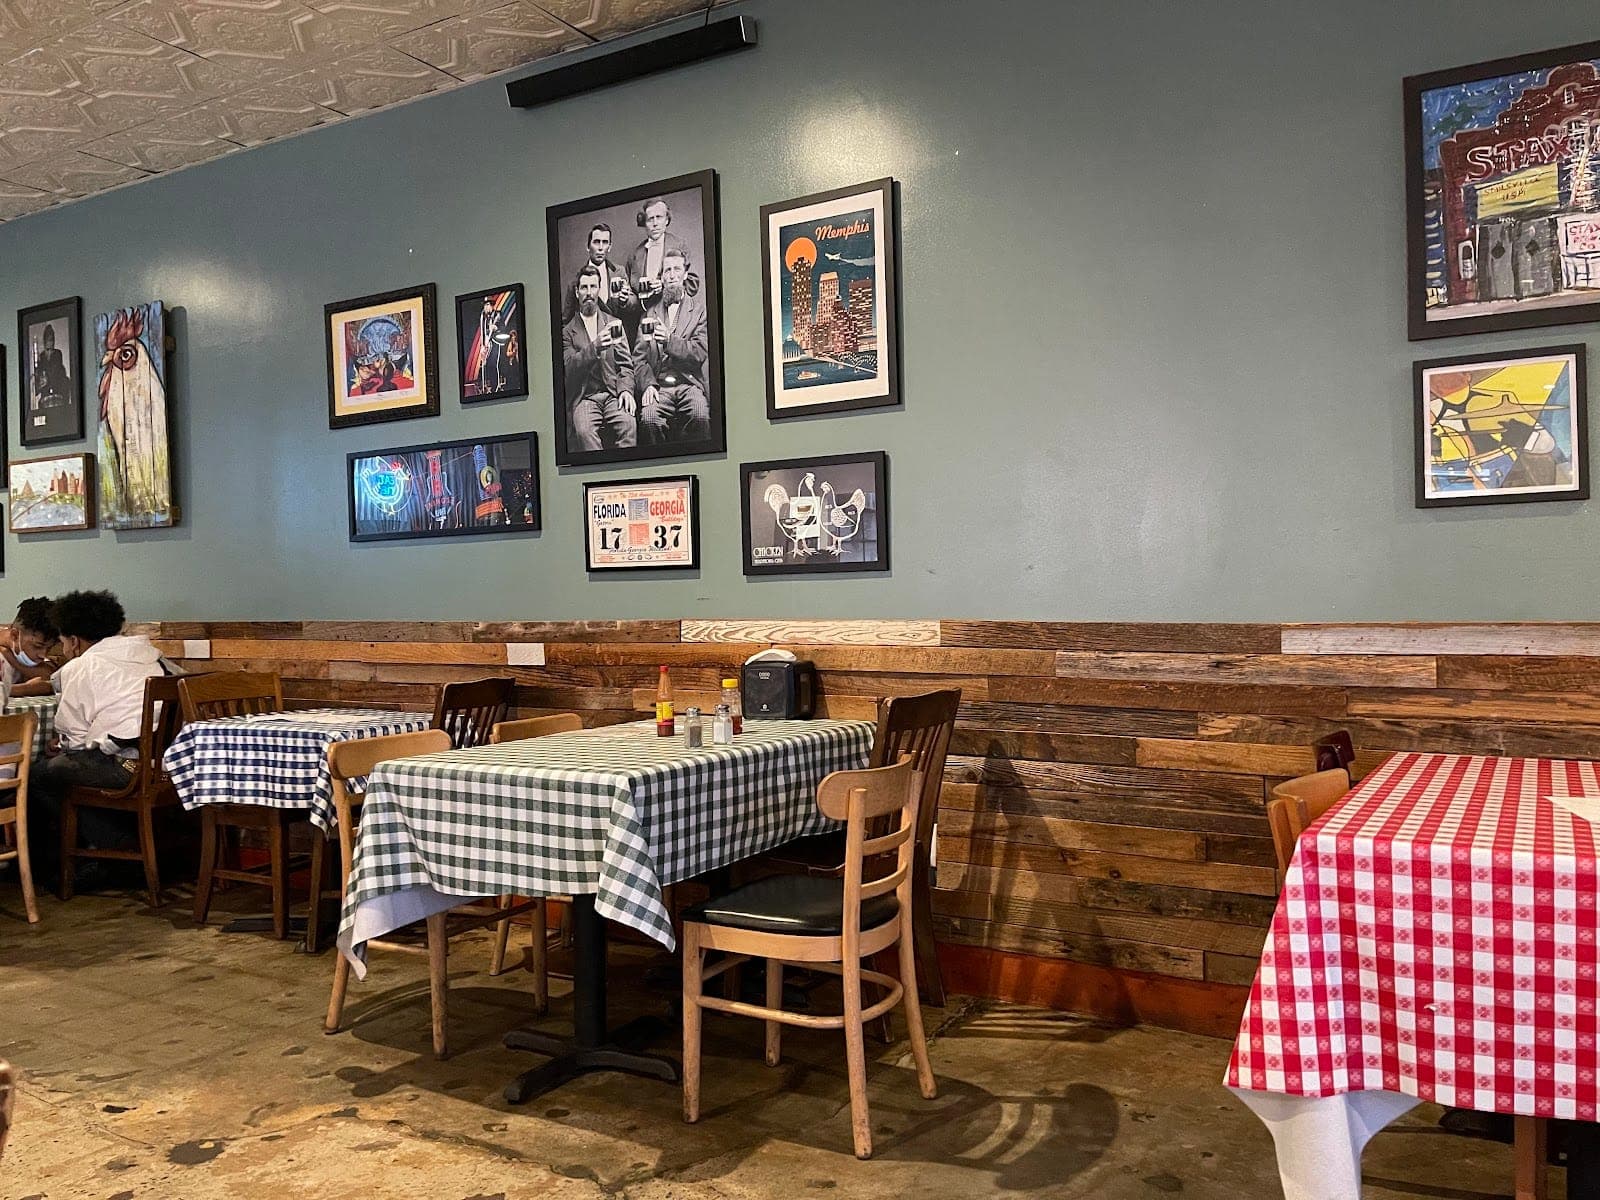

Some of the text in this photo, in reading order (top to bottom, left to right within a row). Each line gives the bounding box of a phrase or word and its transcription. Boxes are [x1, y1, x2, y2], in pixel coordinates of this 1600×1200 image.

[1465, 135, 1574, 181] STAX
[815, 220, 870, 242] Memphis
[593, 503, 627, 519] FLORIDA
[649, 500, 685, 516] GEORGIA
[600, 527, 623, 550] 17
[654, 525, 682, 549] 37
